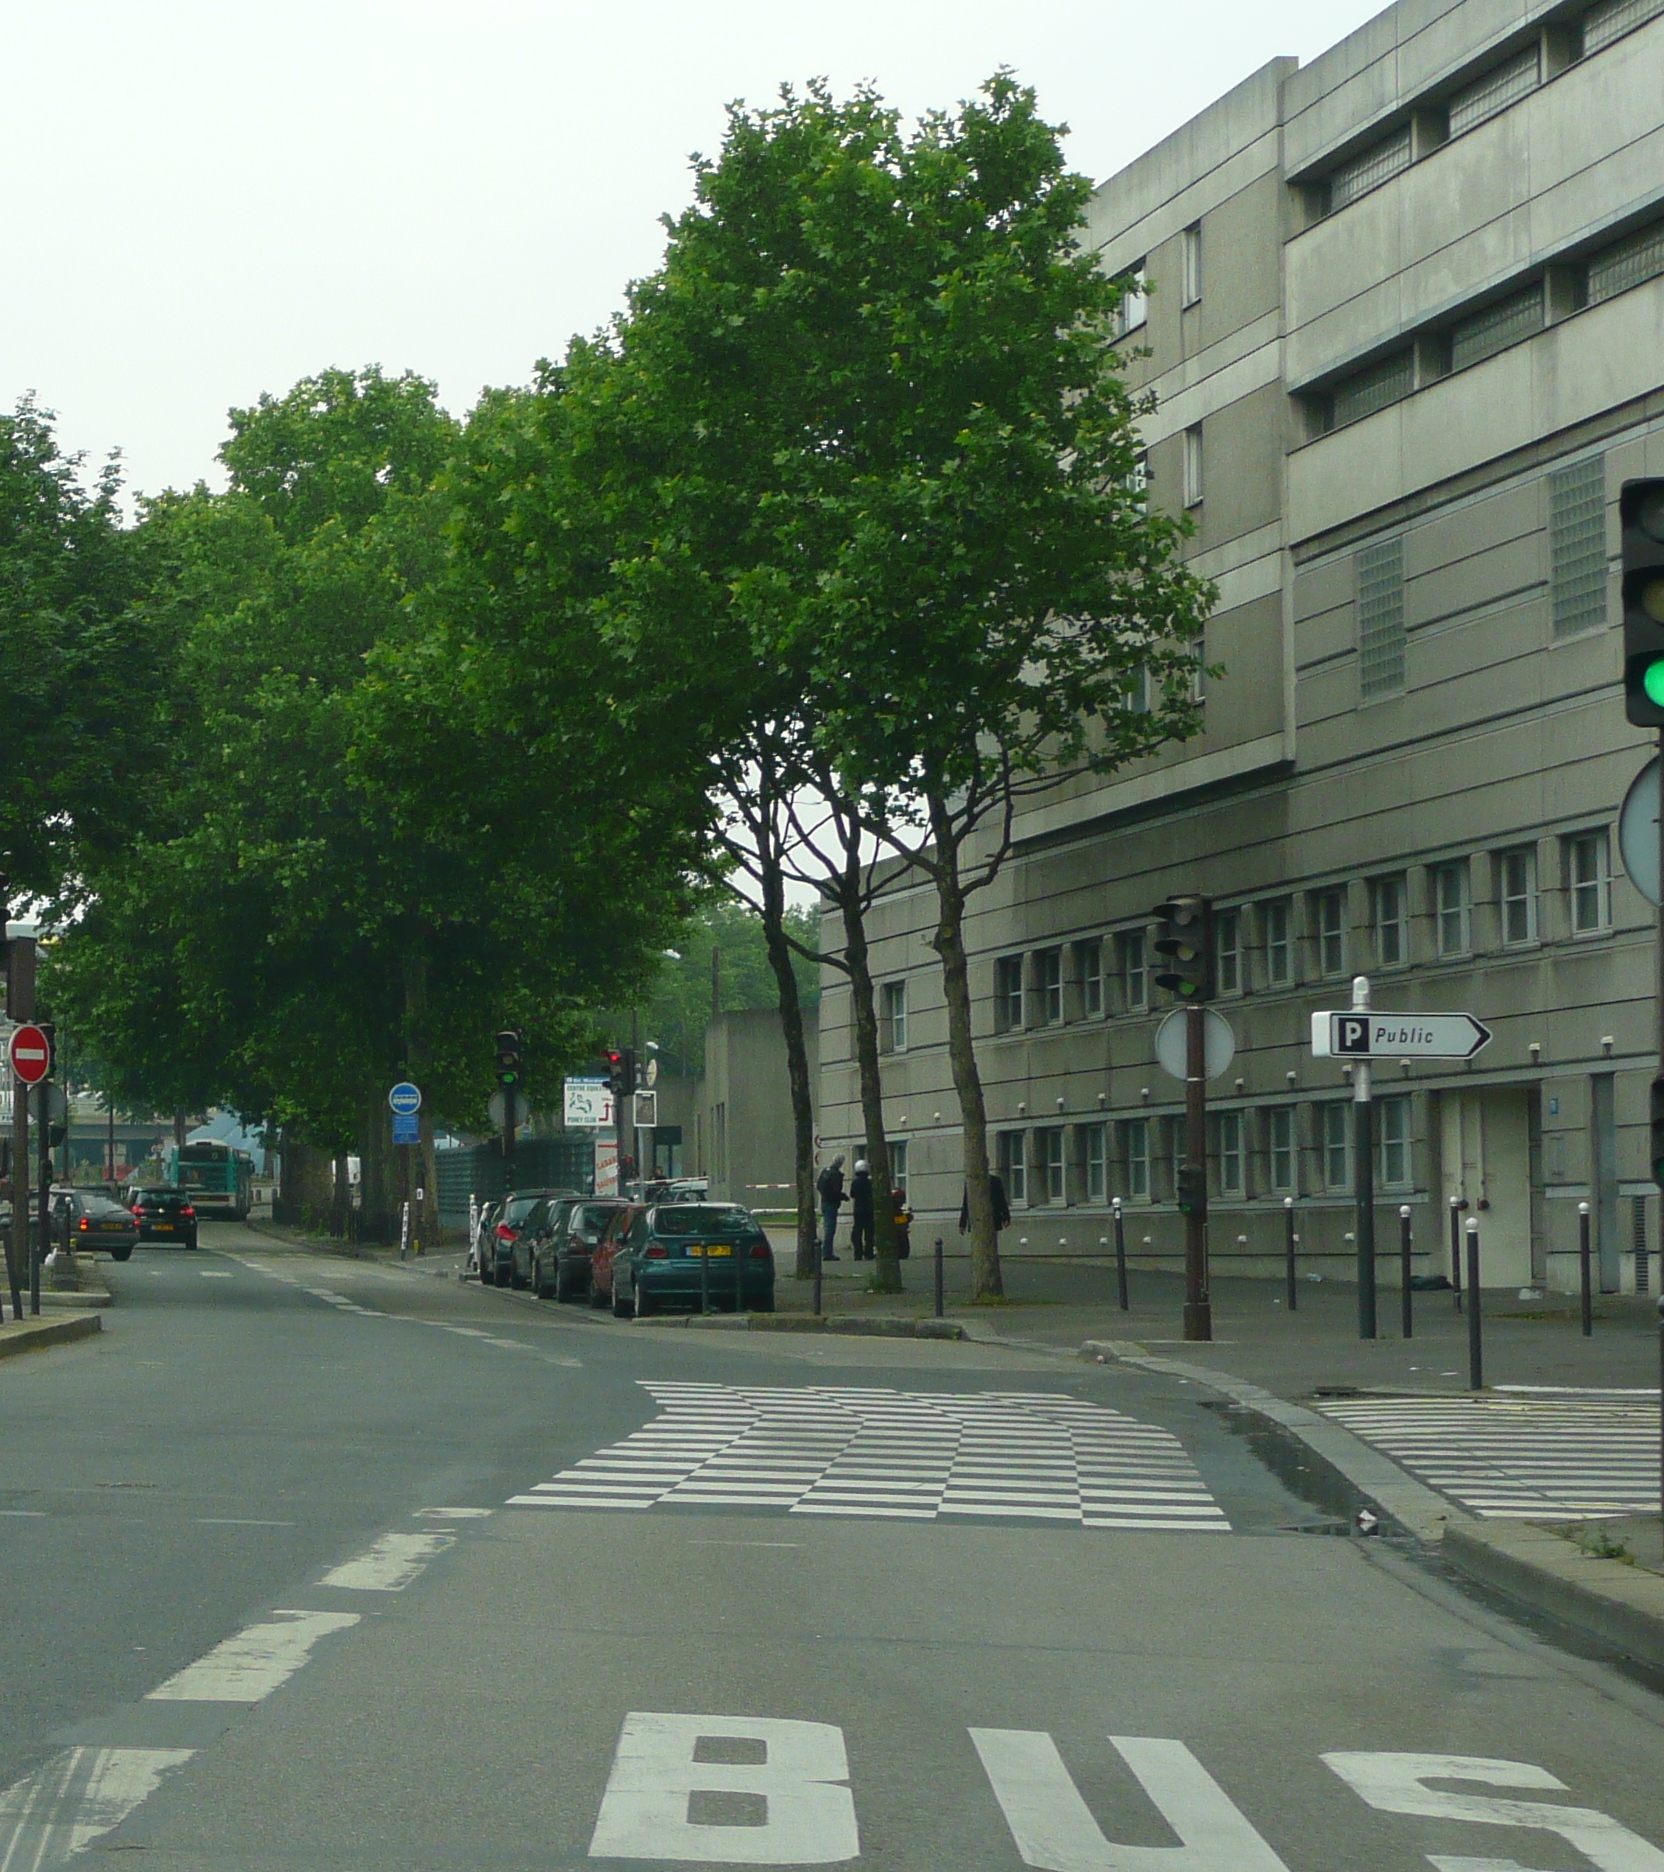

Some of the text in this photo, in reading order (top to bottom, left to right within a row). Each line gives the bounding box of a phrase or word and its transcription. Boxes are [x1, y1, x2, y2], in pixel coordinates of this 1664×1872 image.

[1345, 1021, 1434, 1047] P Public
[587, 1711, 1664, 1872] BUS
